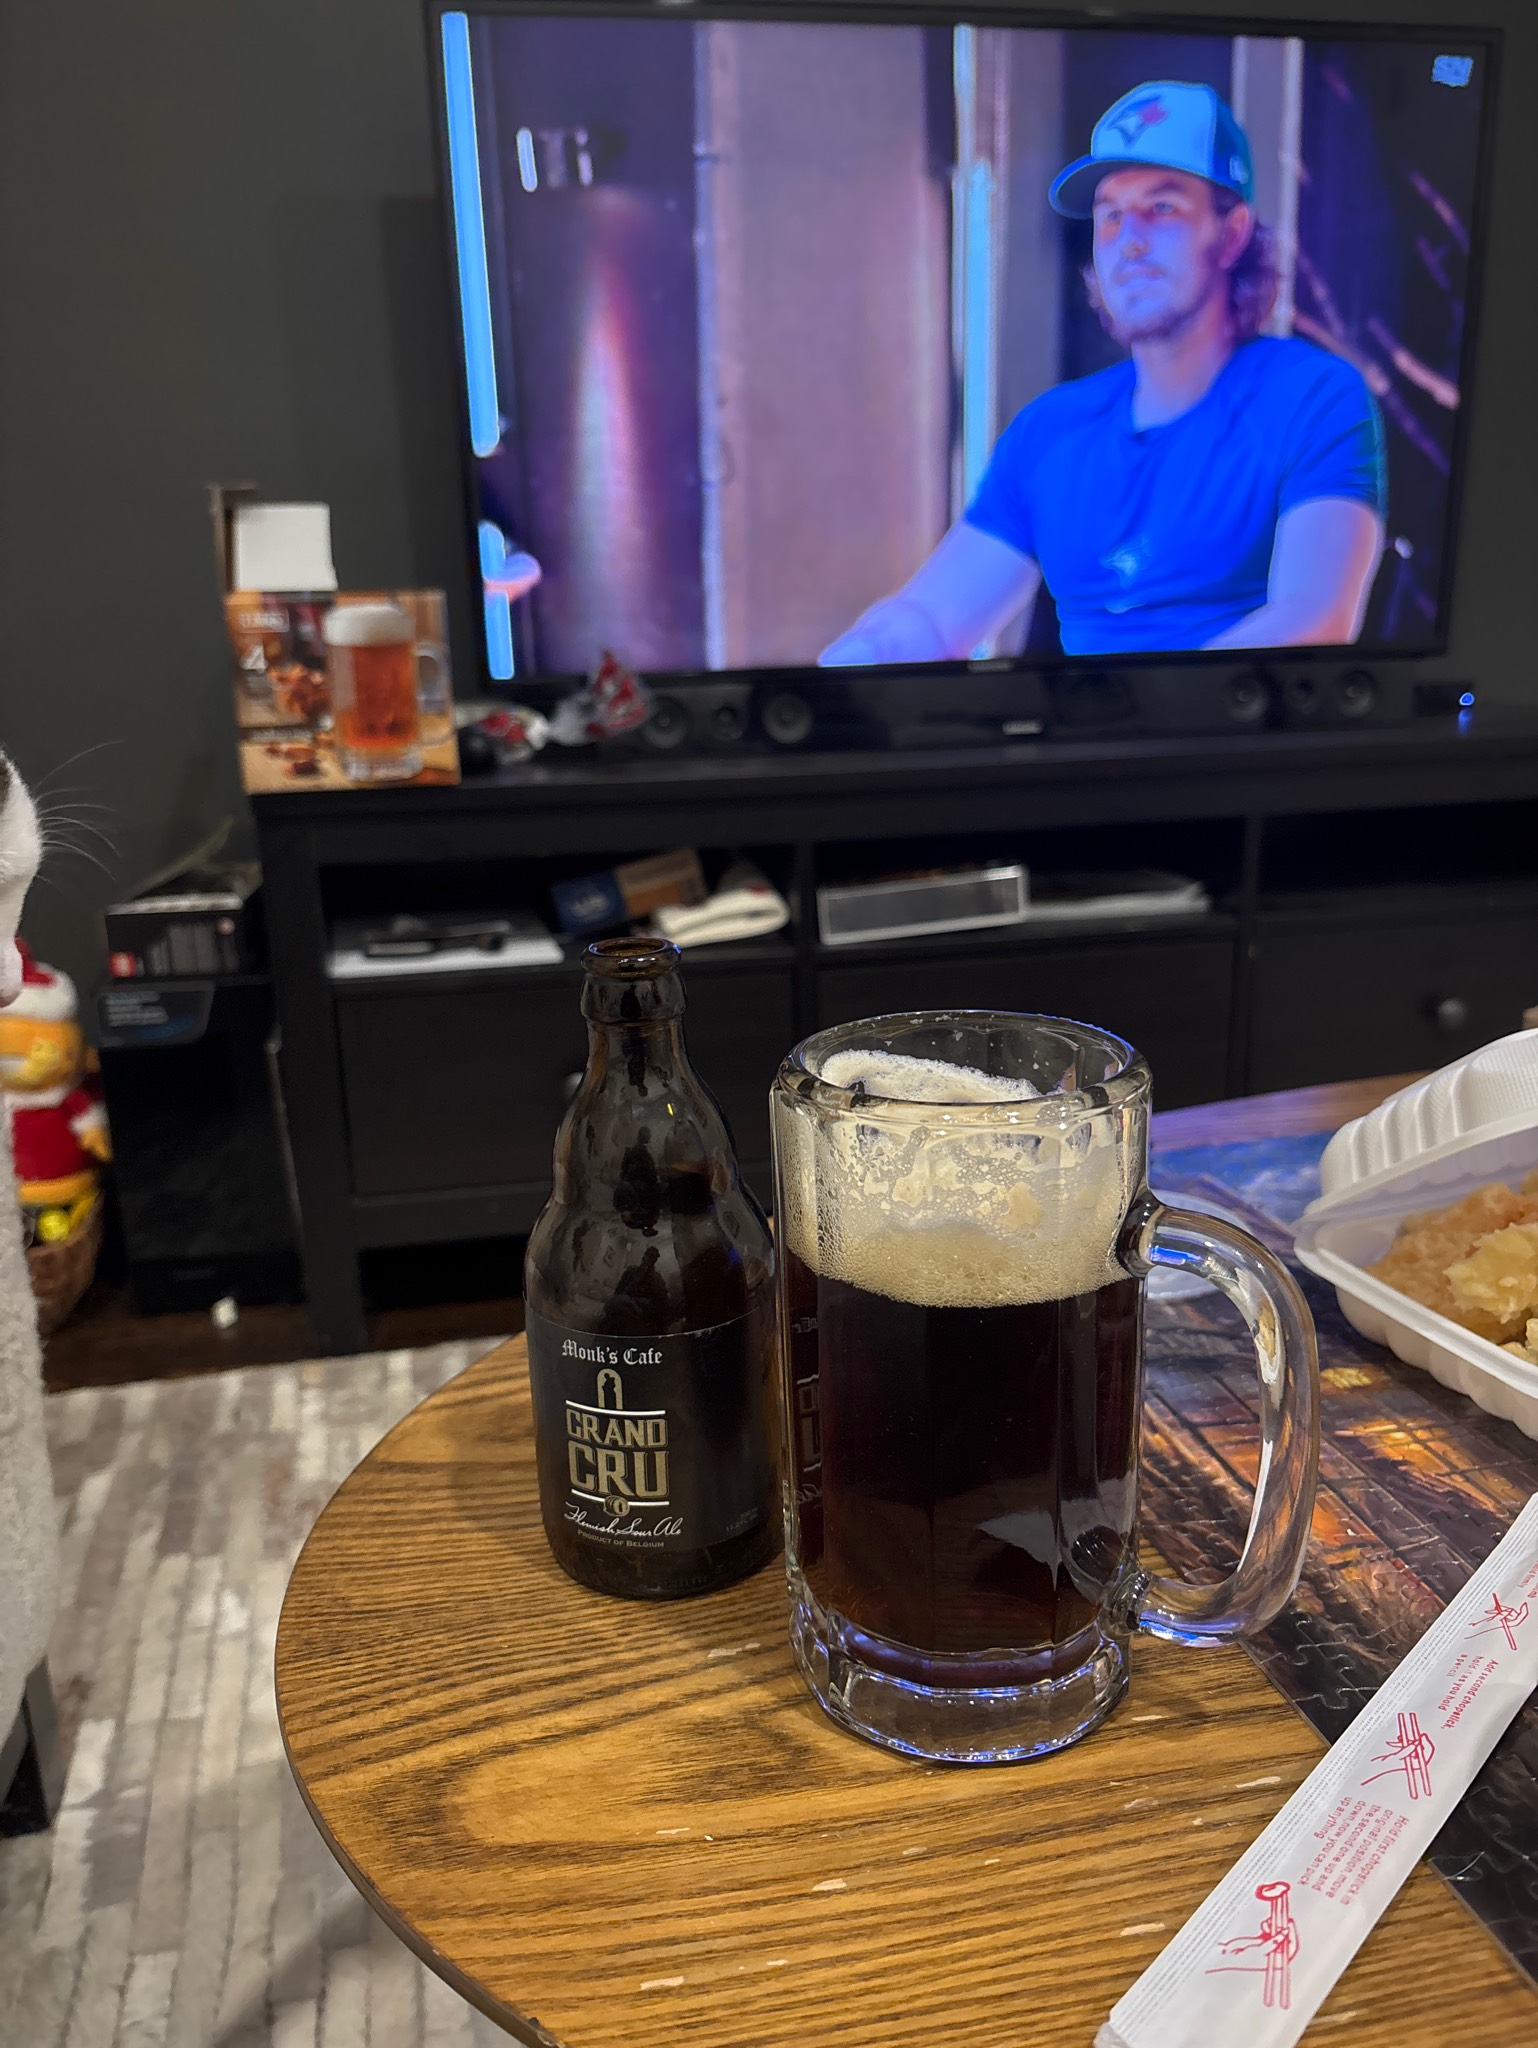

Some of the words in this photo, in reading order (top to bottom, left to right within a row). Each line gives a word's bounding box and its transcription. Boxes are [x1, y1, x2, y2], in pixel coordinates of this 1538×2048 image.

[561, 1339, 618, 1364] Monk's
[623, 1347, 663, 1365] Cafe
[566, 1408, 668, 1448] GRAND
[568, 1440, 669, 1498] CRU
[563, 1501, 616, 1534] Flemish
[616, 1517, 652, 1537] Sour
[653, 1516, 683, 1536] Ale
[1313, 1806, 1345, 1839] anything
[1344, 1818, 1369, 1847] second
[1389, 1816, 1409, 1837] Hold
[1311, 1853, 1326, 1868] can
[1332, 1846, 1349, 1862] one
[1311, 1874, 1328, 1892] and
